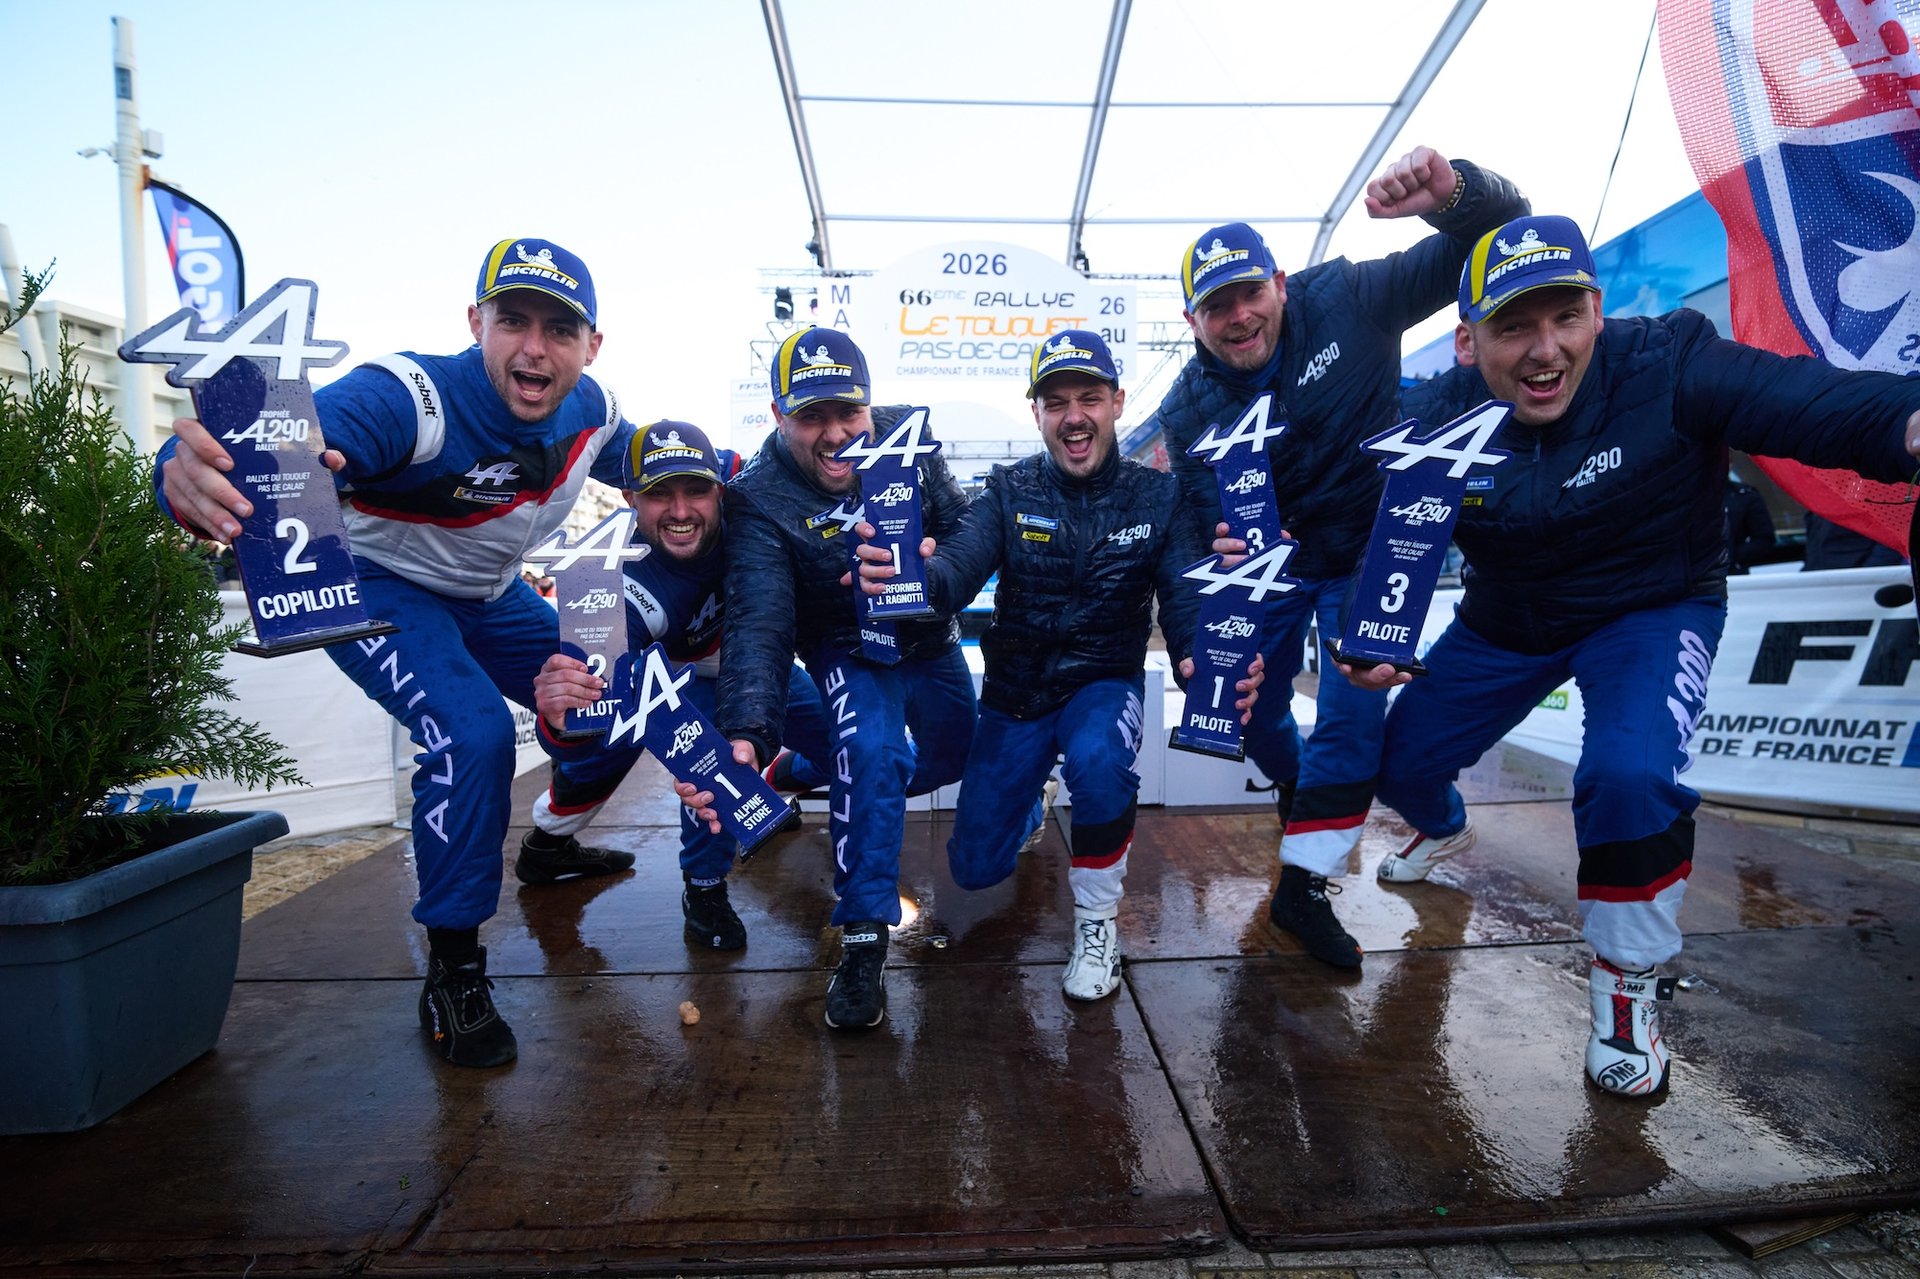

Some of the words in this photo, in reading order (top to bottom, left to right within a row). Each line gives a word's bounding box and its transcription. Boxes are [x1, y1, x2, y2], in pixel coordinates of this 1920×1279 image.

[942, 253, 1007, 276] 2026
[1193, 249, 1249, 284] MICHELIN
[1486, 247, 1572, 285] MICHELIN
[500, 266, 579, 291] MICHELIN
[974, 292, 1075, 307] RALLYE
[1100, 297, 1125, 315] 26
[955, 316, 1088, 338] TOUQUET
[1101, 327, 1125, 343] au
[792, 366, 851, 382] MICHELIN
[896, 366, 962, 376] CHAMPIONNAT
[967, 366, 978, 376] DE
[983, 366, 1020, 376] FRANCE
[1038, 351, 1093, 373] MICHELIN
[1298, 342, 1340, 387] A290
[409, 371, 437, 418] Sabelt
[259, 410, 290, 418] TROPHÉE
[743, 414, 768, 424] IGOL
[221, 419, 309, 444] A290
[255, 443, 280, 451] RALLYE
[644, 449, 704, 466] MICHELIN
[1561, 446, 1622, 488] A290
[1225, 472, 1266, 492] A290
[869, 487, 913, 503] A290
[1388, 501, 1452, 523] A290
[1107, 524, 1151, 542] A290
[1246, 527, 1265, 556] 3
[275, 518, 317, 575] 2
[890, 543, 901, 575] 1
[625, 584, 658, 614] Sabelt
[876, 596, 885, 606] J.
[886, 593, 923, 605] RAGNOTTI
[881, 582, 922, 594] RFORMER
[1380, 572, 1410, 613] 3
[257, 584, 360, 620] COPILOTE
[565, 593, 618, 609] A290
[861, 629, 896, 648] COPILOTE
[1204, 620, 1256, 637] A290
[1357, 621, 1411, 644] PILOTE
[587, 653, 608, 688] 2
[1211, 675, 1225, 708] 1
[1190, 713, 1233, 734] PILOTE
[1695, 714, 1907, 741] AMPIONNAT
[357, 636, 452, 853] ALPINE
[665, 720, 703, 759] A290
[1701, 737, 1743, 756] DE
[1753, 740, 1896, 767] FRANCE
[825, 667, 857, 874] ALPINE
[714, 772, 742, 800] 1
[733, 793, 764, 823] ALPINE
[743, 804, 773, 831] STORE
[1601, 1063, 1637, 1089] OMP
